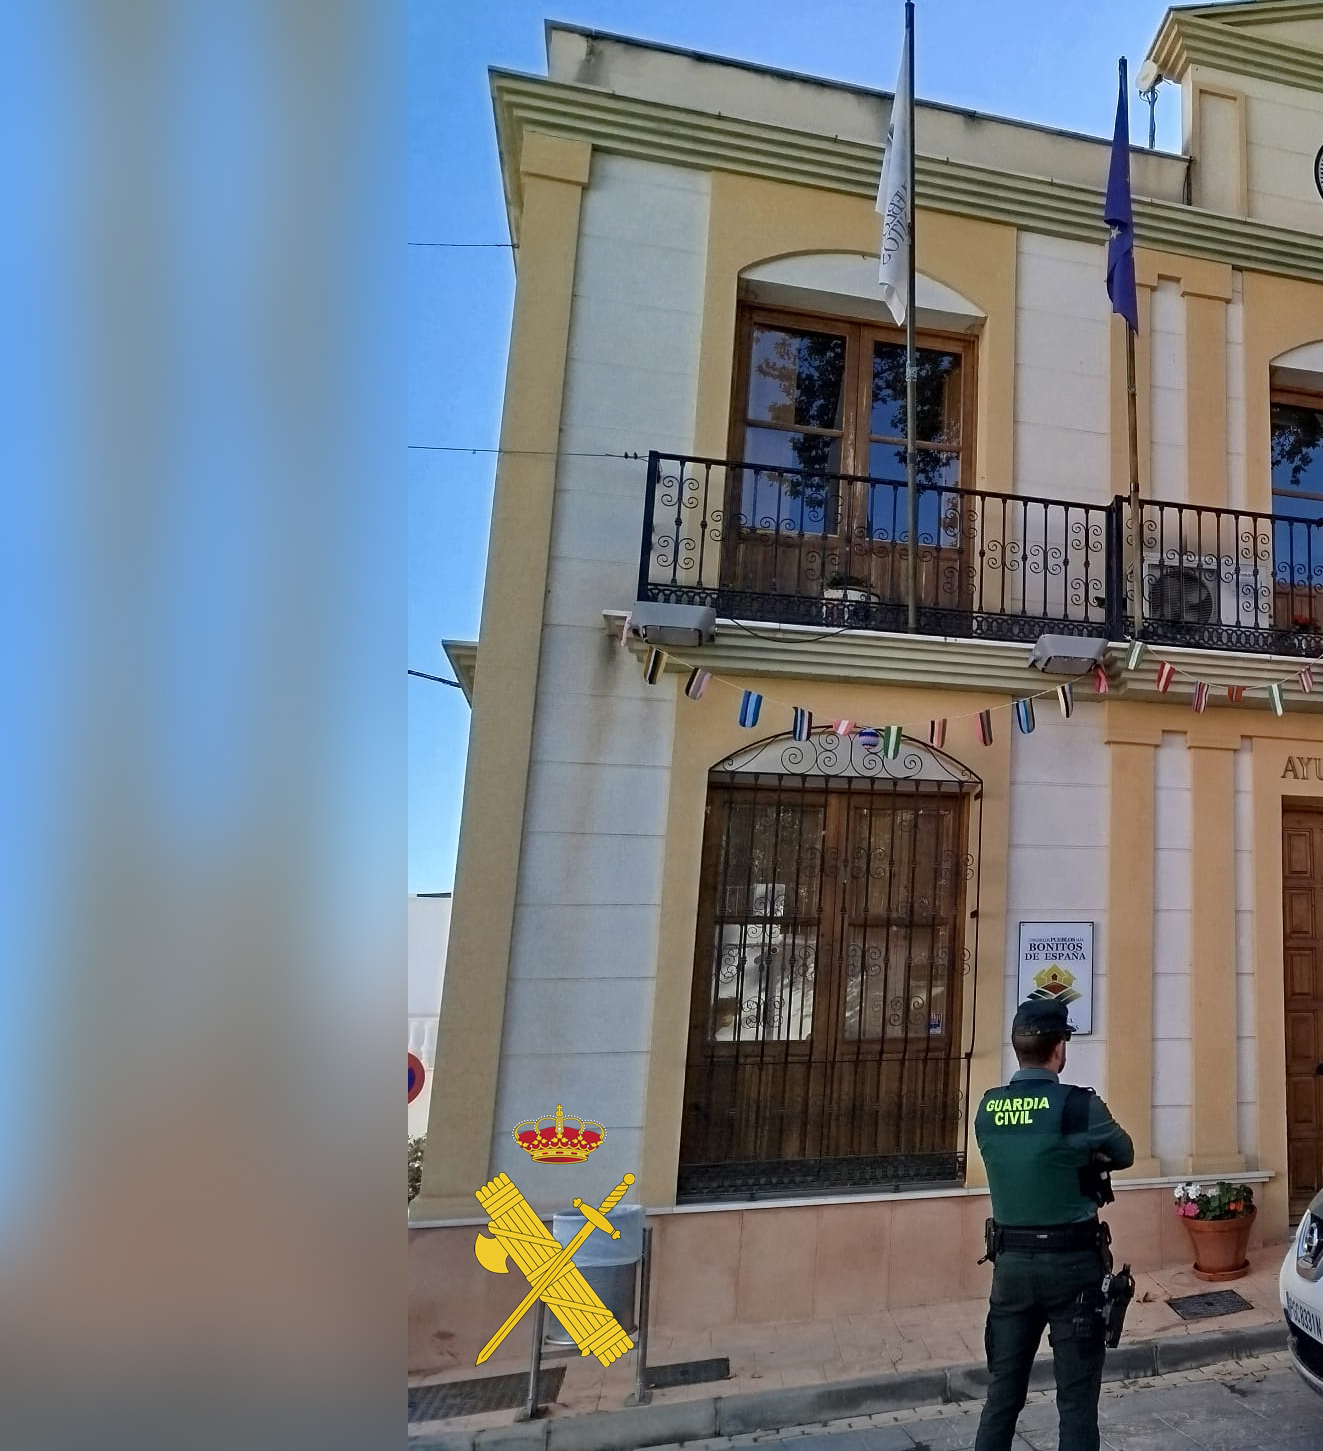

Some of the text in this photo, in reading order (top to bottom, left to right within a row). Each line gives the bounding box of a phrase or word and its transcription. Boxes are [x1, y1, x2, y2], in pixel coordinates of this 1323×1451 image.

[1029, 942, 1083, 951] BONITOS
[1025, 951, 1086, 960] DE ESPAÑA
[986, 1096, 1050, 1112] GUARDIA
[994, 1110, 1033, 1126] CIVIL
